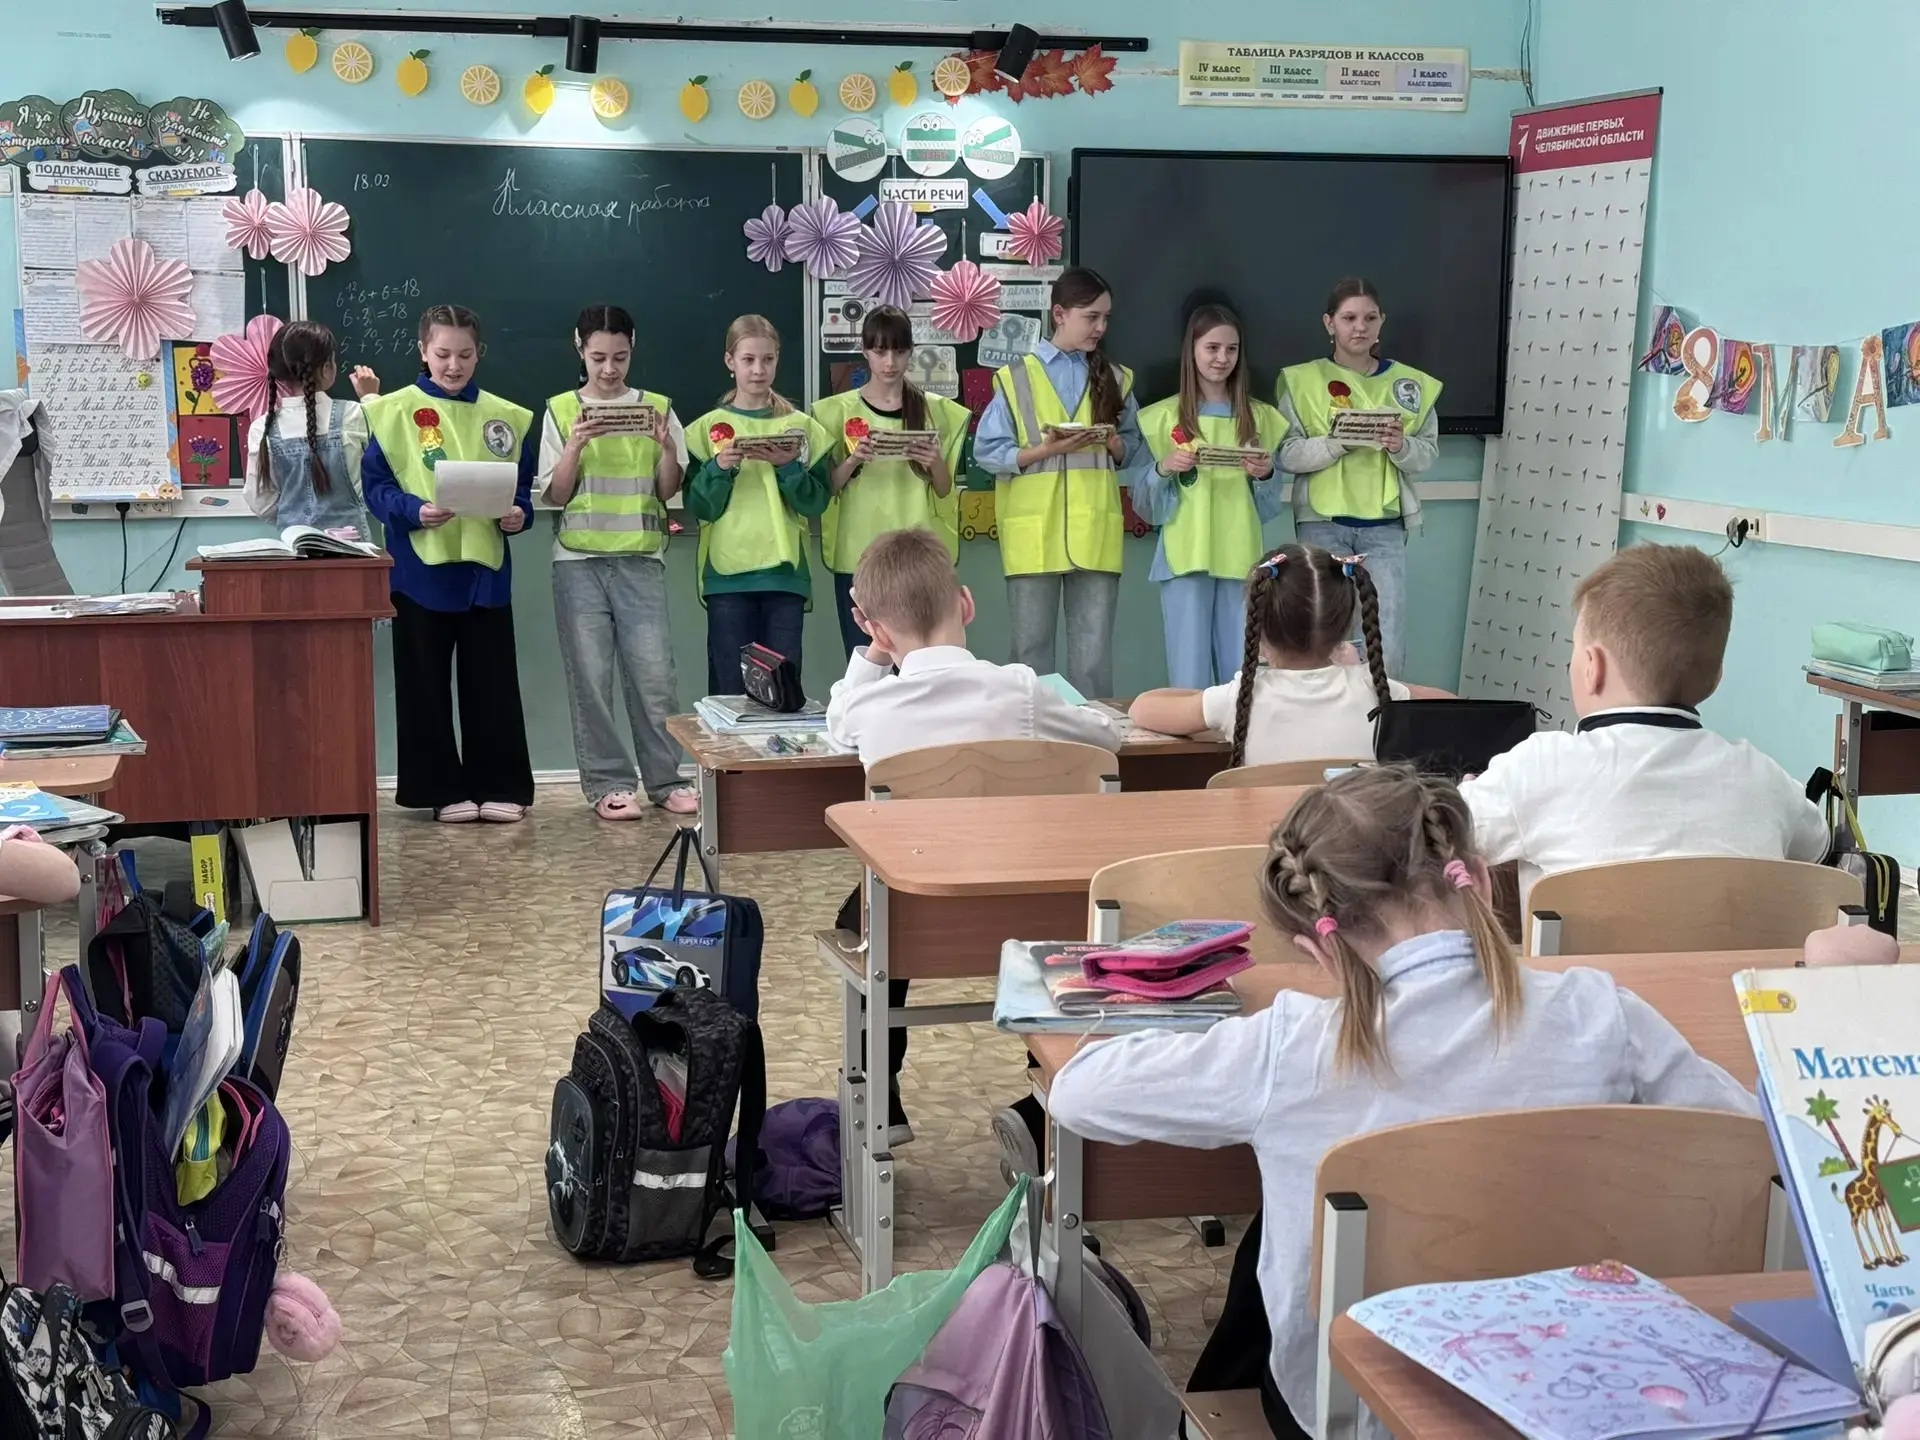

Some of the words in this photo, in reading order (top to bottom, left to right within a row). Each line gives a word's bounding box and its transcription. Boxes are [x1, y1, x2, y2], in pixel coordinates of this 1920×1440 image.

[1227, 47, 1286, 58] ТАБЛИЦА
[1289, 49, 1352, 60] РАЗРЯДОВ
[1355, 51, 1364, 60] И
[1368, 52, 1424, 61] КЛАССОВ
[1199, 63, 1209, 72] IV
[1212, 65, 1241, 73] класс
[1270, 65, 1281, 74] III
[1284, 67, 1312, 76] класс
[1341, 67, 1349, 76] II
[1352, 69, 1380, 77] класс
[1420, 70, 1447, 78] класс
[17, 105, 31, 127] Я
[35, 111, 53, 129] за
[75, 97, 146, 126] Лучший
[191, 101, 212, 120] Не
[161, 117, 228, 147] задавайте
[1536, 122, 1585, 140] ДВИЖЕНИЕ
[1586, 117, 1625, 132] ПЕРВЫХ
[83, 132, 135, 152] класс!
[1535, 134, 1599, 153] ЧЕЛЯБИНСКОЙ
[1600, 130, 1644, 147] ОБЛАСТИ
[35, 164, 121, 178] ПОДЛЕЖАЩЕЕ
[148, 166, 222, 181] СКАЗУЕМОЕ
[54, 178, 75, 186] КТО?
[79, 179, 98, 187] ЧТО?
[492, 168, 621, 220] Классная
[628, 184, 711, 233] работа
[883, 189, 926, 201] ЧАСТИ
[930, 189, 964, 201] РЕЧИ
[983, 349, 1020, 362] ГЛАГО
[1673, 328, 1717, 421] 8
[201, 859, 209, 884] НАБОР
[678, 938, 698, 946] SUPER
[699, 938, 714, 946] FAST
[1790, 1046, 1920, 1080] Матем
[1864, 1283, 1916, 1298] Часть
